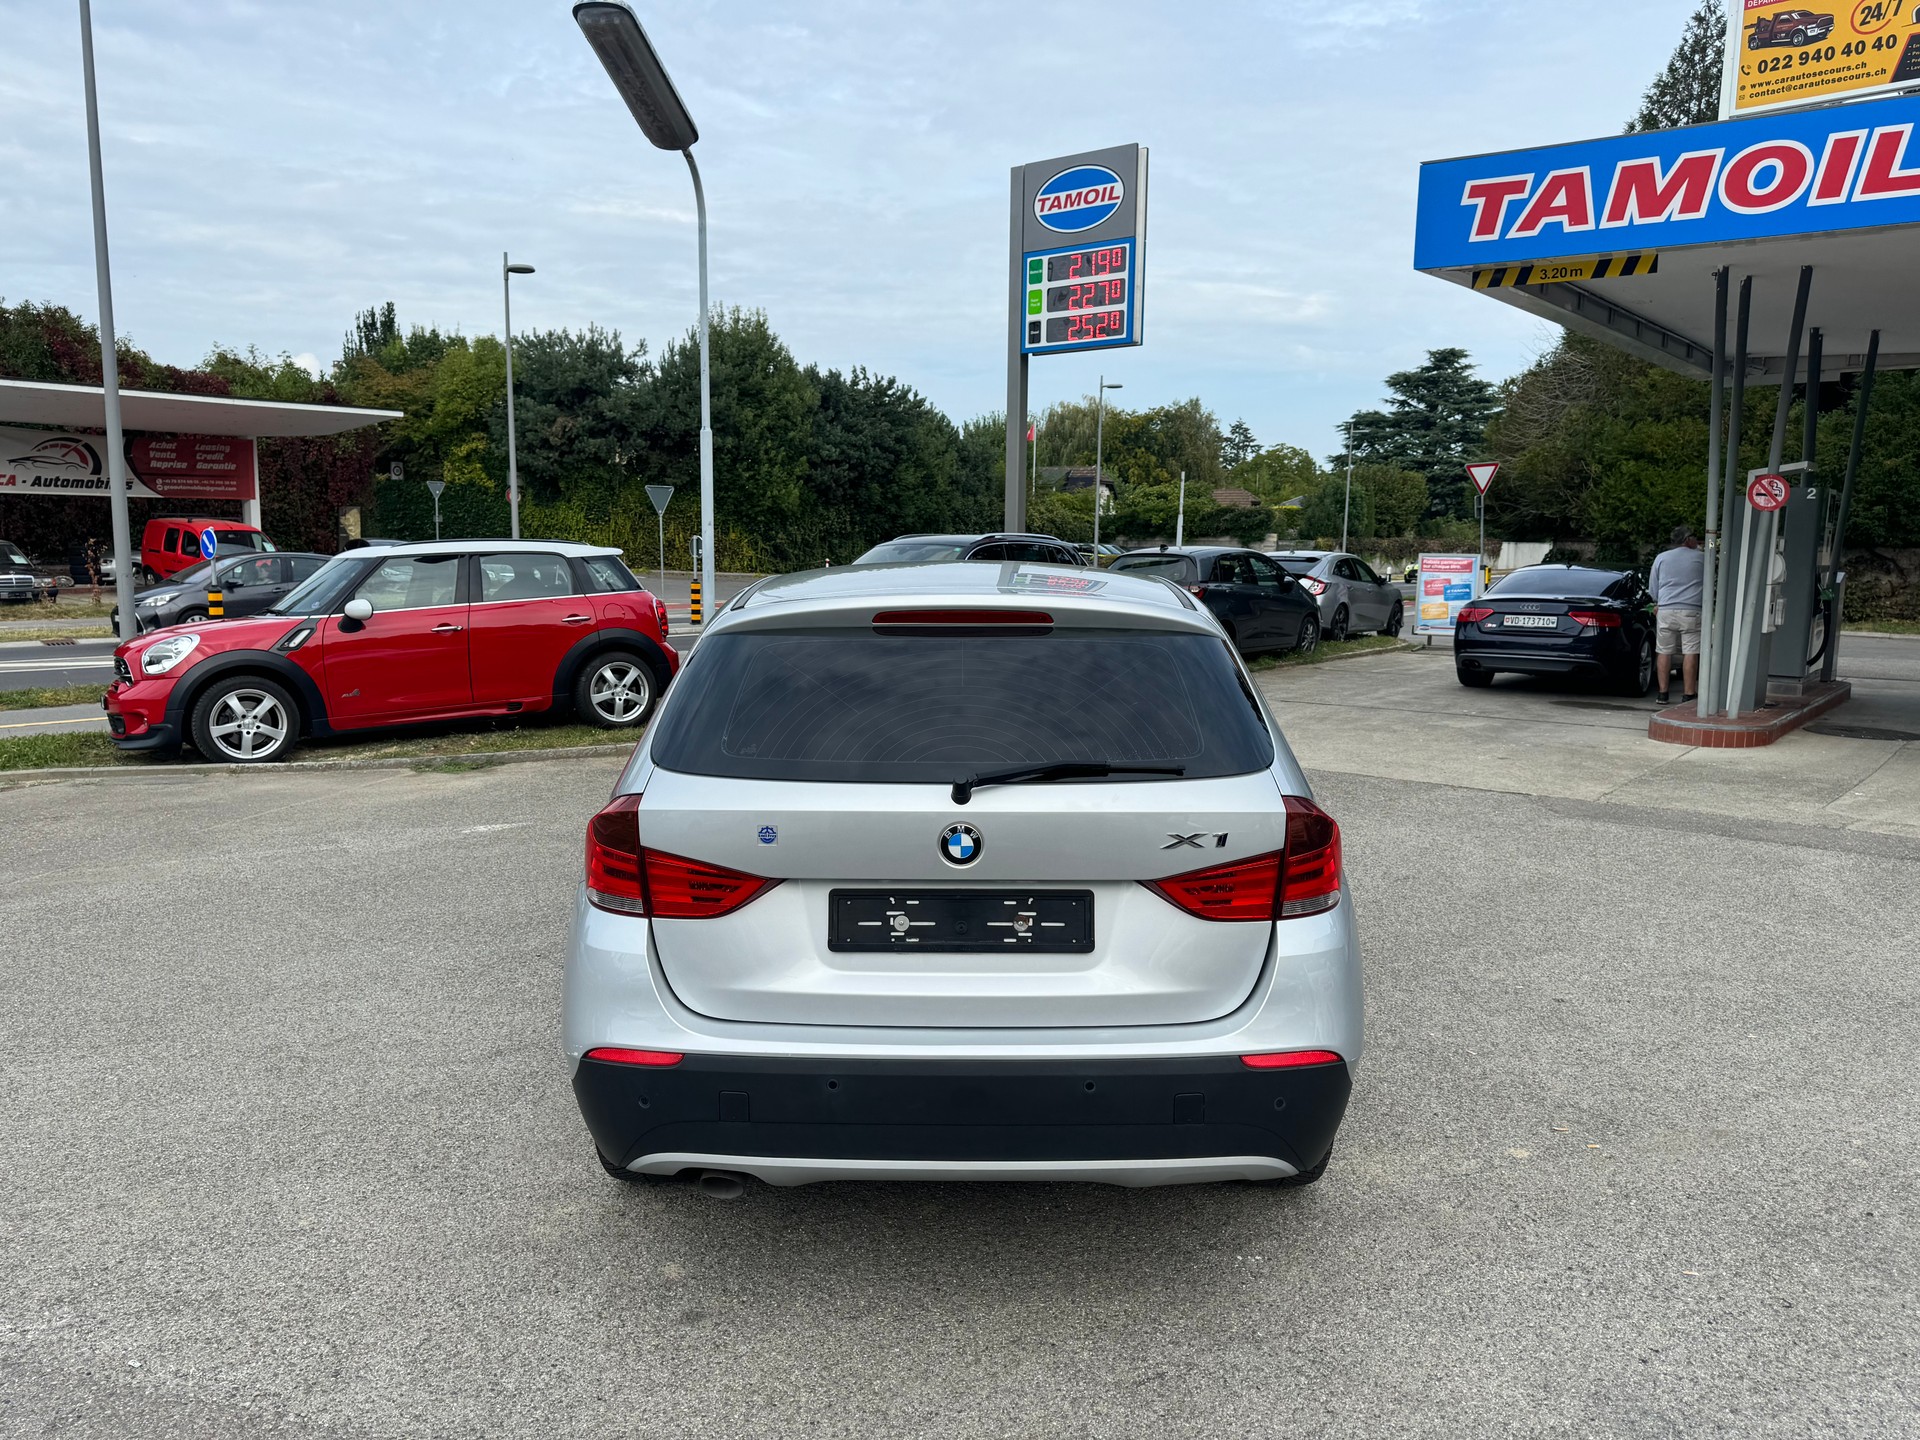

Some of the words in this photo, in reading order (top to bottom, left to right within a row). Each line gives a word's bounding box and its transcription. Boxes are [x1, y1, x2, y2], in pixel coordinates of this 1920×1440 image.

[1757, 55, 1793, 74] 022
[1798, 46, 1836, 66] 940
[1841, 40, 1866, 58] 40
[1872, 34, 1897, 50] 40
[1750, 61, 1867, 89] www.carautosecours.ch
[1749, 67, 1887, 99] contact@carautosecours.ch
[1461, 123, 1920, 243] TAMOIL
[1037, 185, 1121, 213] TAMOIL
[1540, 267, 1567, 280] 3.20
[1570, 268, 1583, 277] m
[149, 450, 176, 459] Vente
[195, 443, 231, 453] Leasing
[150, 460, 188, 469] Reprise
[196, 461, 237, 470] Garantie
[1806, 488, 1817, 500] 2
[944, 825, 979, 840] BMW
[1160, 832, 1229, 849] X1
